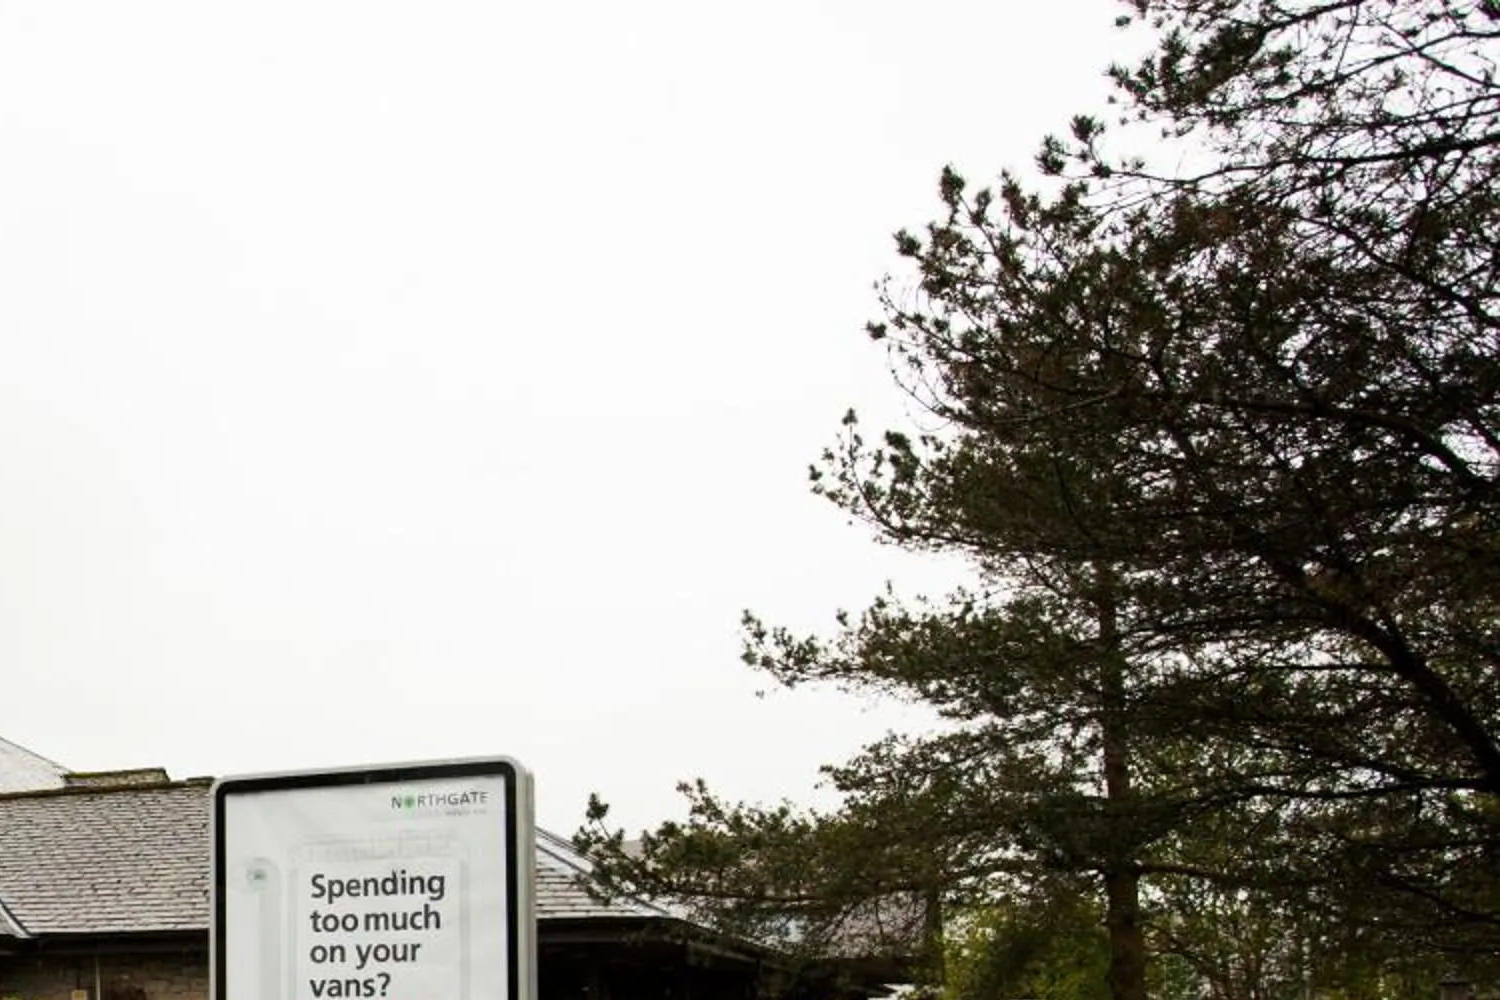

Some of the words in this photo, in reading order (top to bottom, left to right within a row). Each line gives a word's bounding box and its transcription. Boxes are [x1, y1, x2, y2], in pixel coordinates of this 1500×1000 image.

[391, 791, 489, 809] NORTHGATE
[310, 869, 446, 904] Spending
[310, 910, 359, 933] too
[364, 903, 442, 932] much
[309, 944, 346, 964] on
[355, 943, 421, 970] your
[309, 972, 391, 998] vans?
